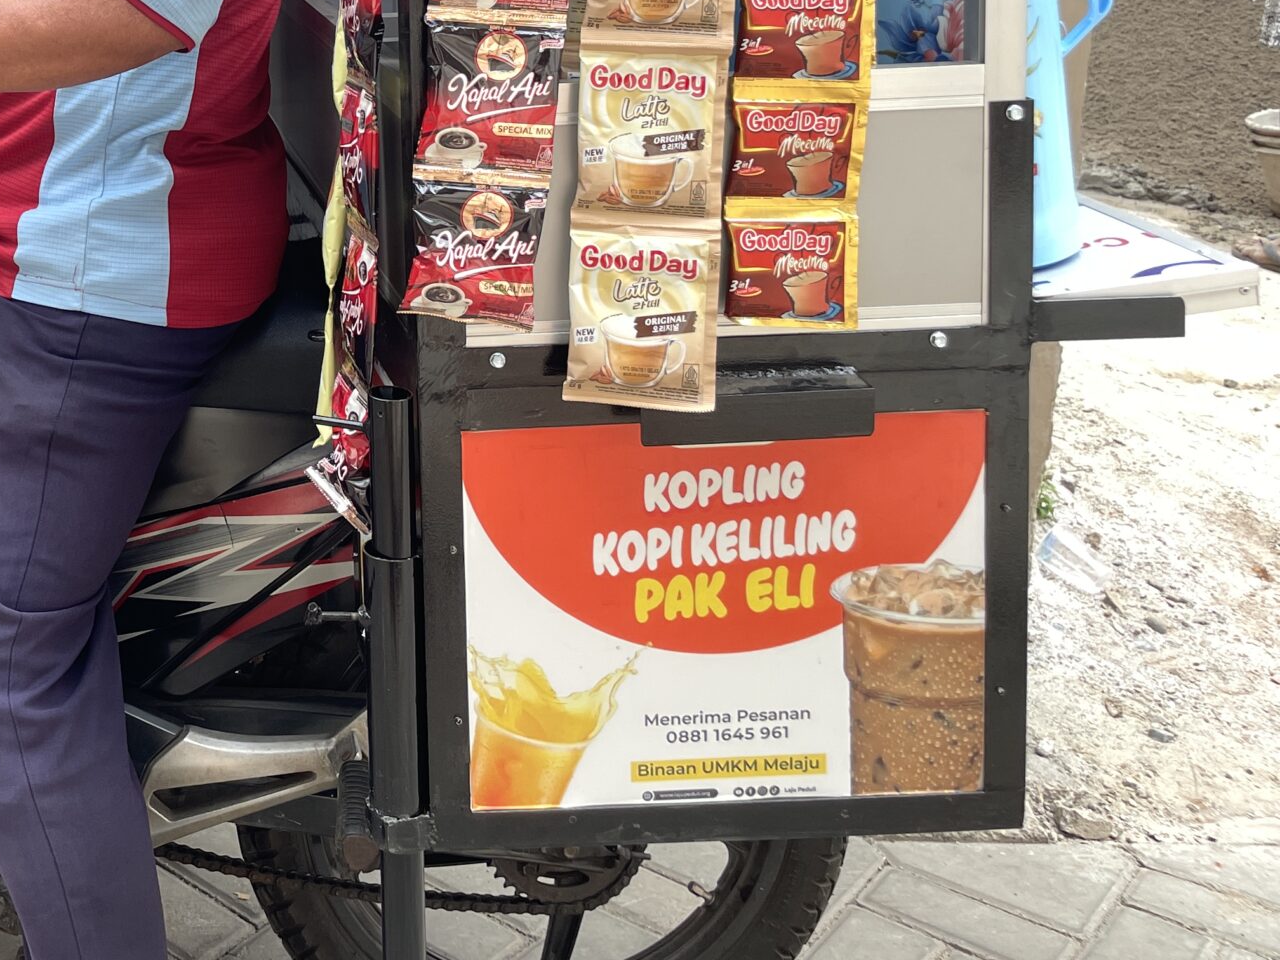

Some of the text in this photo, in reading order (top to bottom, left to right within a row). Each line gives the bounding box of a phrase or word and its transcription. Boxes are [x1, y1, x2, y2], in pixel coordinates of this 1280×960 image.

[446, 72, 554, 115] Kapal Api
[590, 64, 707, 98] Good Day
[621, 95, 670, 122] Latte
[497, 125, 553, 136] SPECIAL MIX
[746, 109, 841, 136] Good Day
[653, 132, 695, 145] ORIGINAL
[584, 148, 604, 157] NEW
[435, 230, 538, 272] Kapal Api
[739, 228, 832, 256] Good Day
[580, 244, 698, 280] Good Day
[613, 277, 662, 303] Latte
[576, 328, 595, 337] NEW
[644, 314, 687, 326] ORIGINAL
[643, 460, 805, 513] KOPLING
[593, 509, 857, 577] KOPI KELILING
[634, 563, 816, 624] PAK ELI
[644, 709, 811, 727] Menerima Pesanan
[666, 726, 789, 744] 0881 1645 961
[638, 756, 820, 777] Binaan UMKM Melaju
